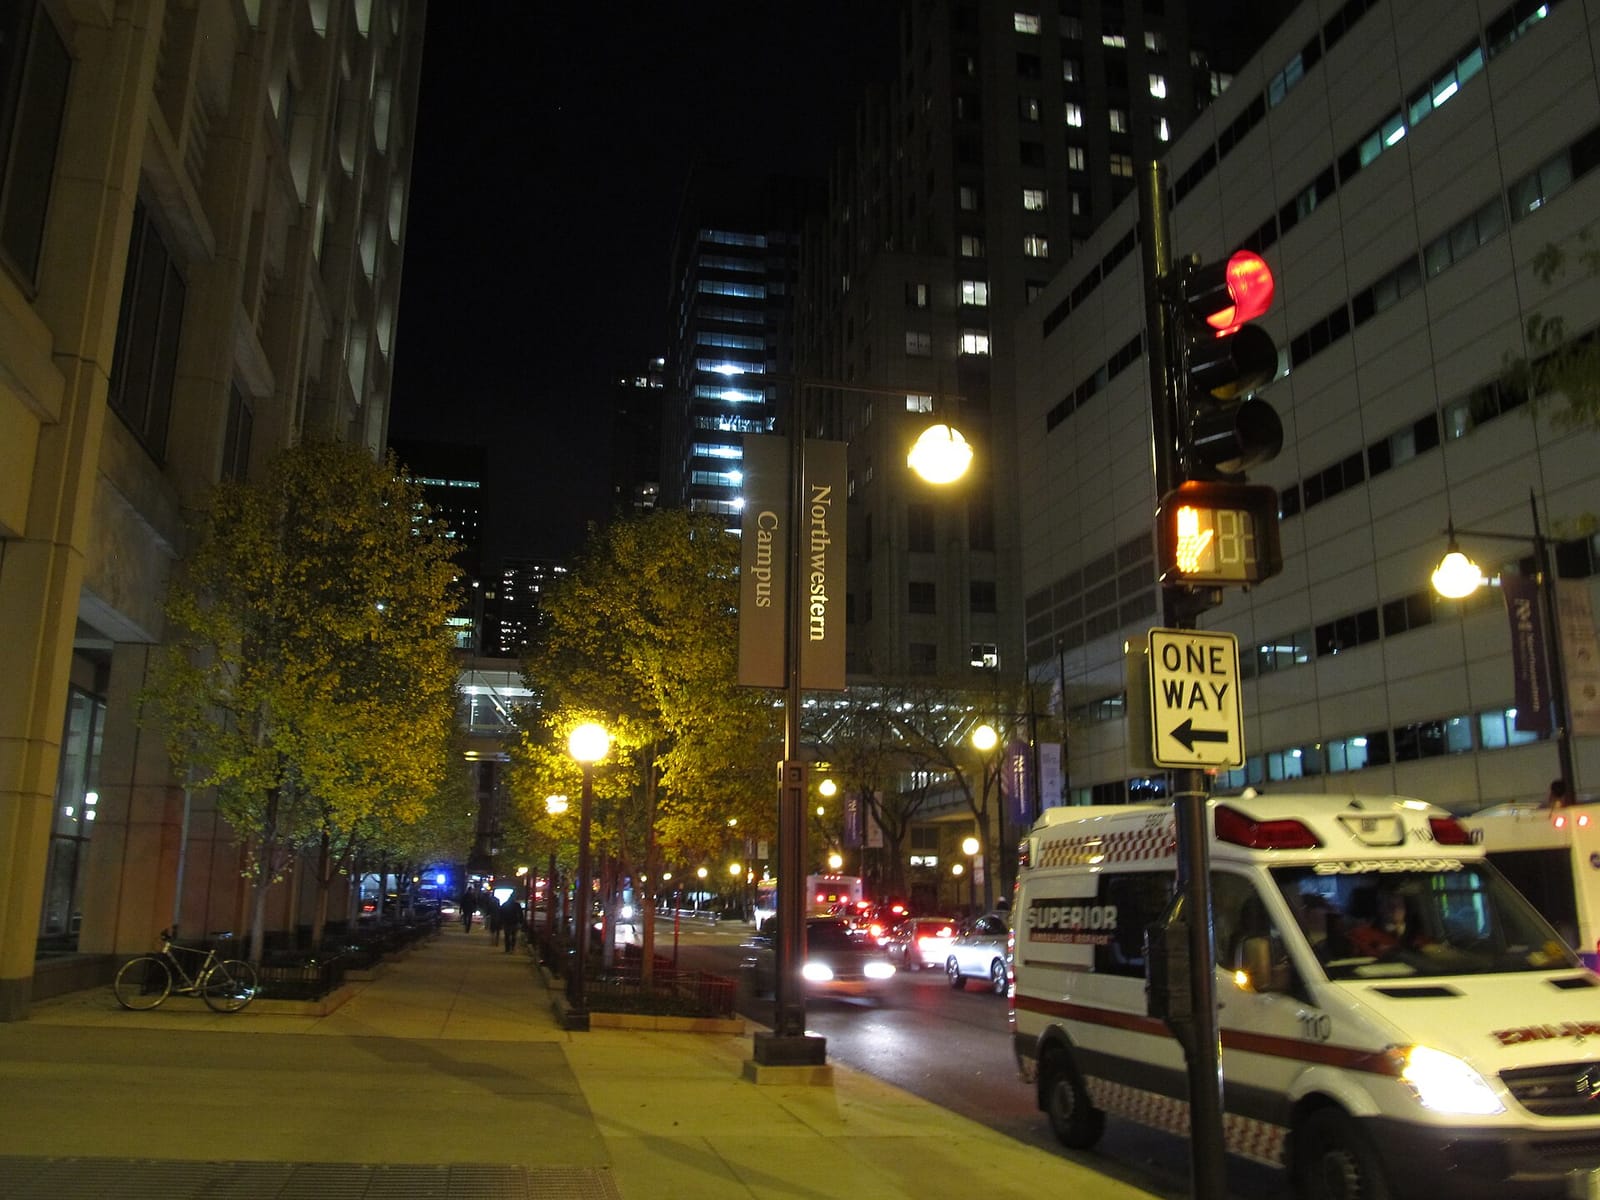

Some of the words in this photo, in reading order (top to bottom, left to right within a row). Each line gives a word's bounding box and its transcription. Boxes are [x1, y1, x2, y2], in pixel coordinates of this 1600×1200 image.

[750, 511, 779, 608] Campus
[810, 484, 832, 642] Northwestern
[1162, 643, 1226, 675] ONE
[1162, 679, 1229, 711] WAY
[1312, 859, 1465, 875] SUPERIOR
[1026, 905, 1118, 930] SUPERIOR
